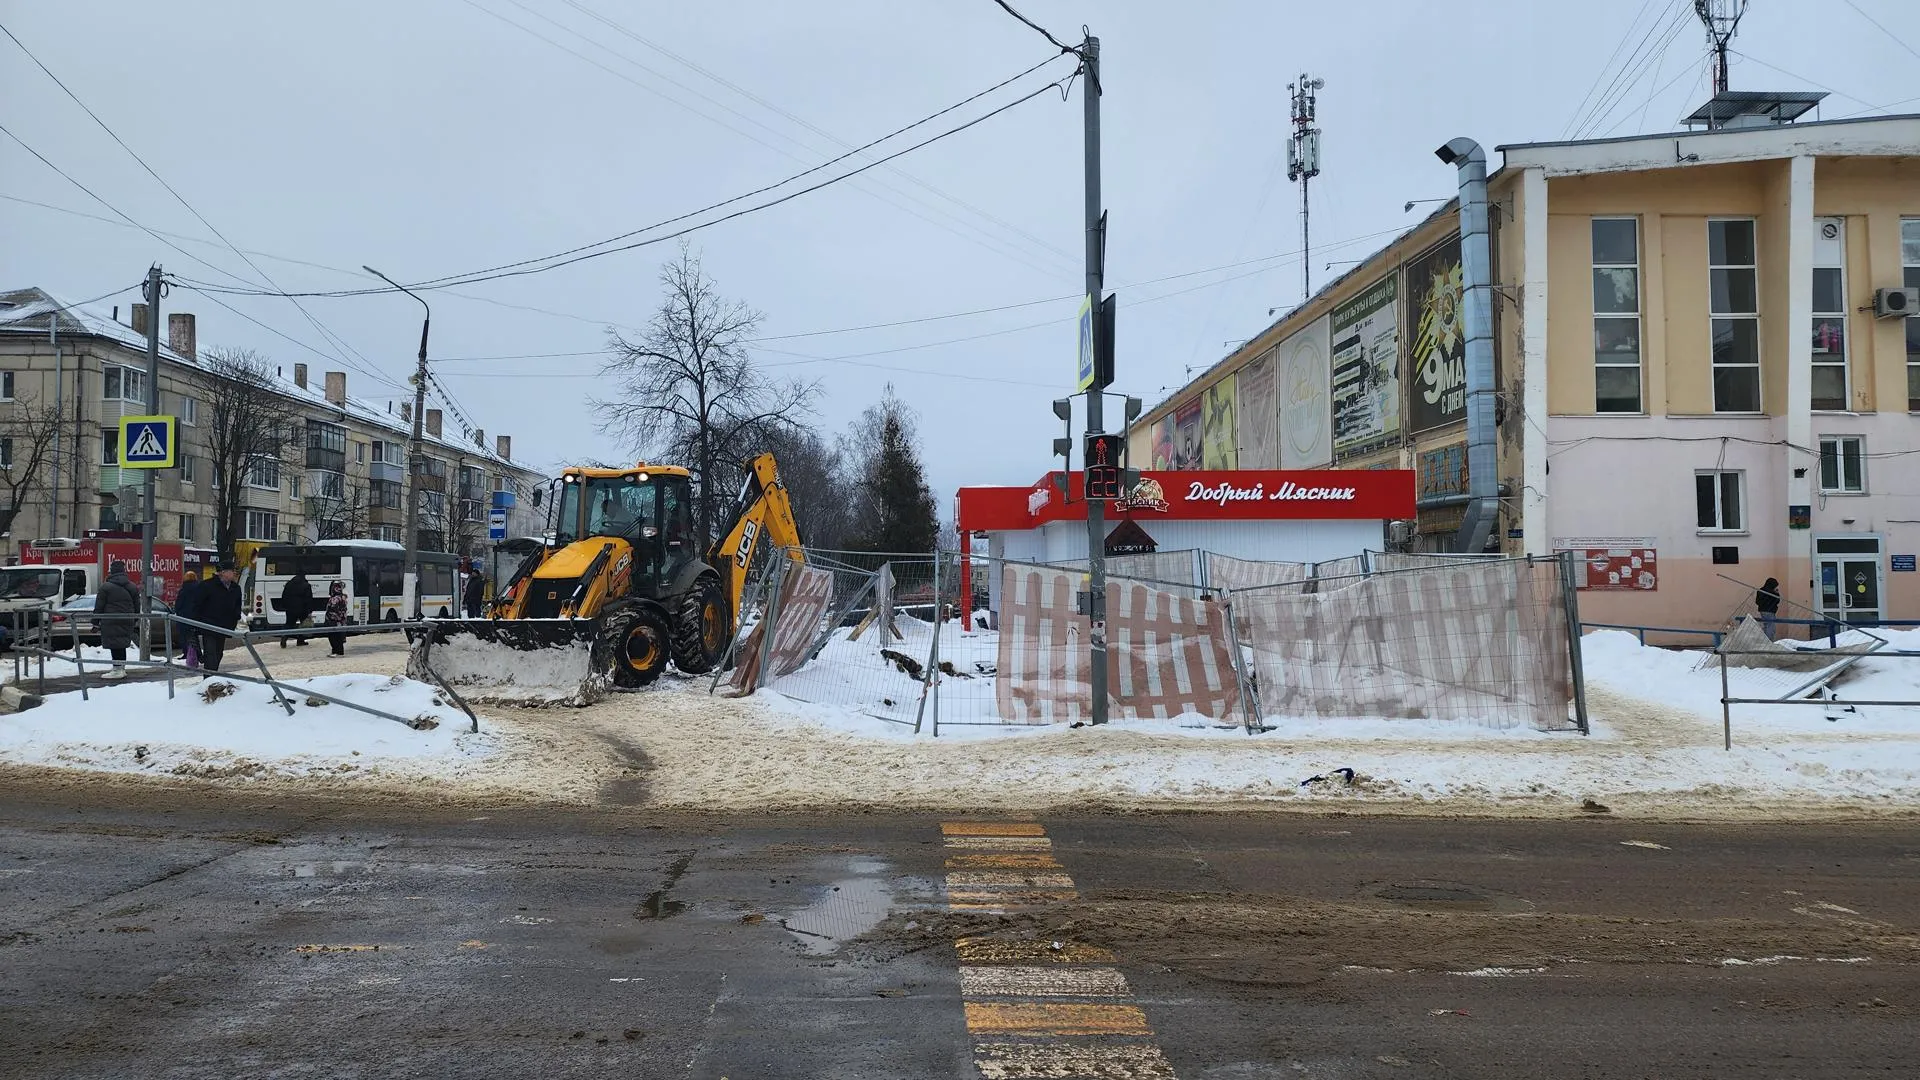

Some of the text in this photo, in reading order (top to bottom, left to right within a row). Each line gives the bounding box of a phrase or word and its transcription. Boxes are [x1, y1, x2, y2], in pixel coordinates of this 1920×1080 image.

[1422, 347, 1444, 404] 9
[1442, 356, 1467, 392] МА
[1091, 468, 1117, 497] 22
[1184, 481, 1356, 506] Добрый Мясник
[738, 521, 756, 569] JCB
[613, 553, 629, 576] JCB
